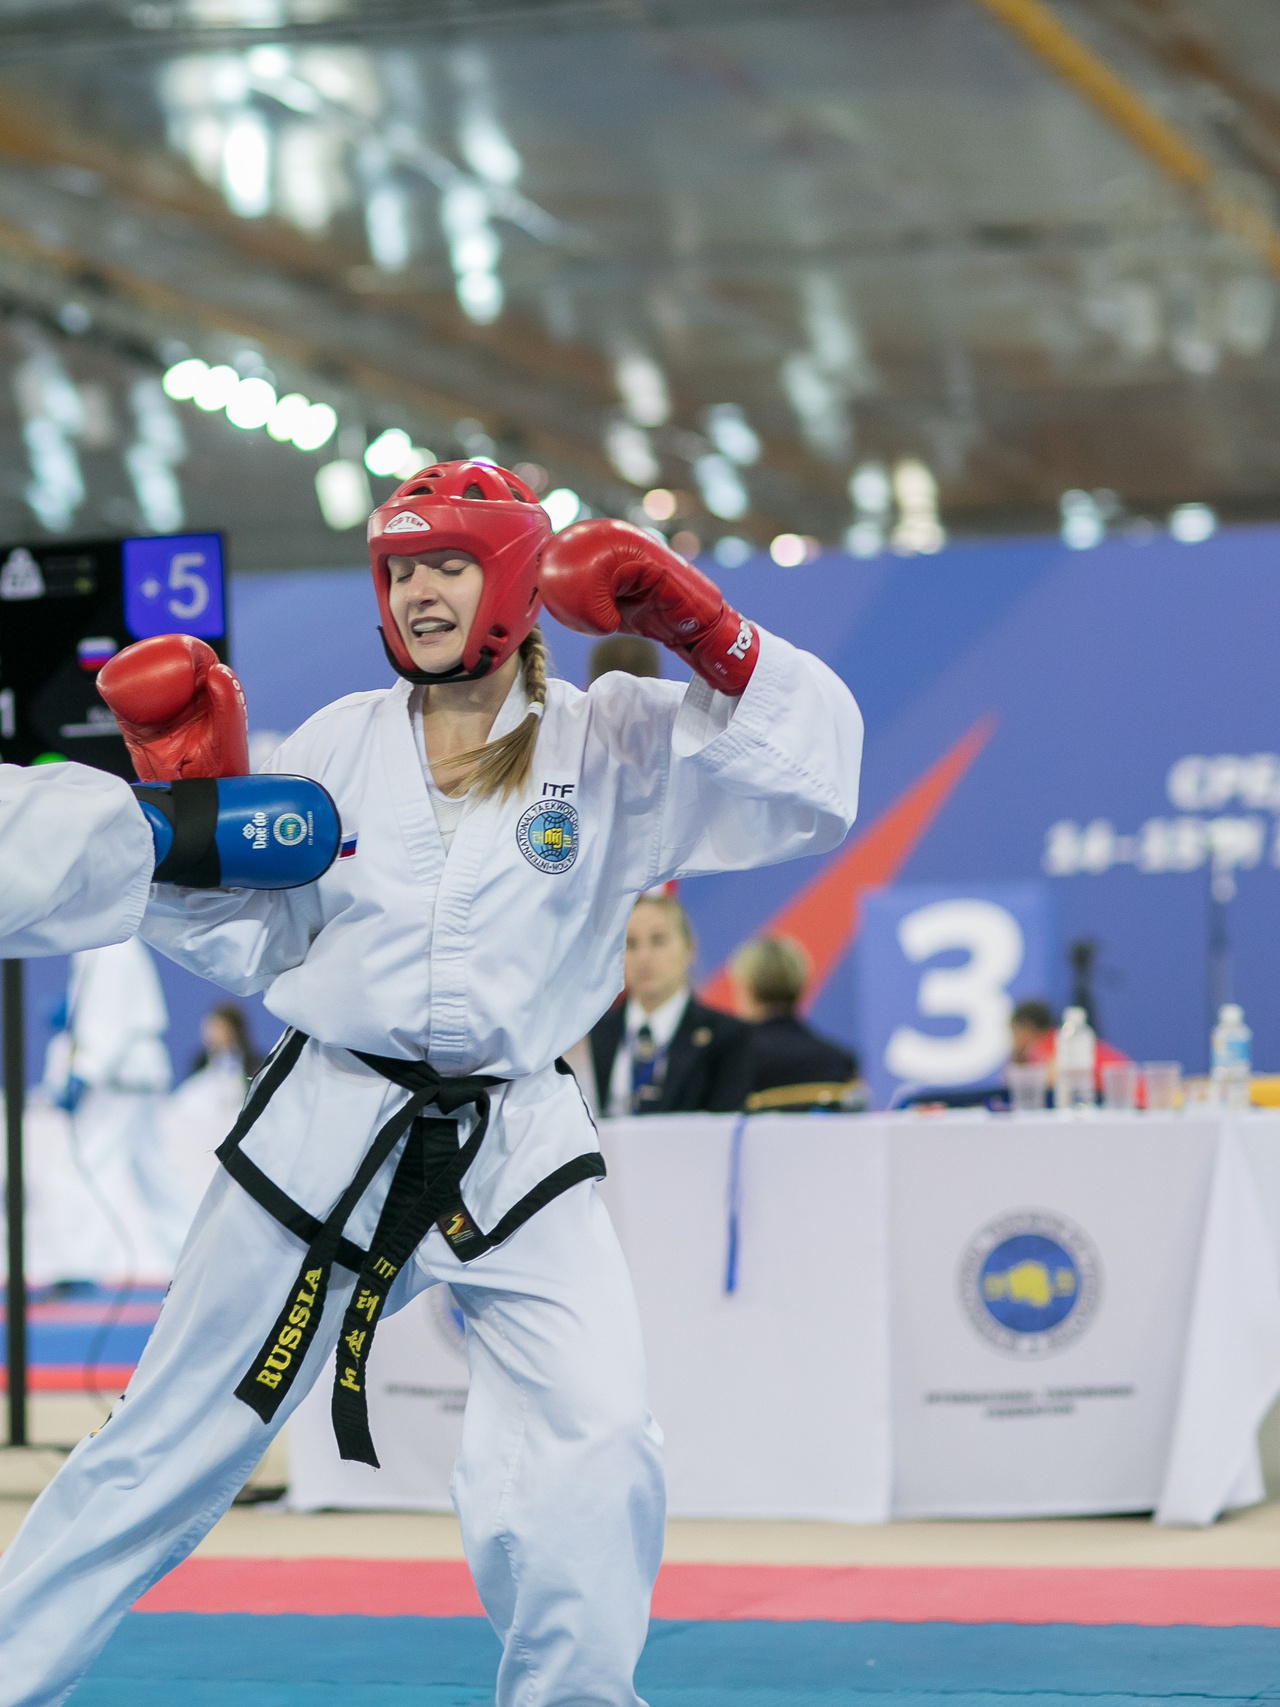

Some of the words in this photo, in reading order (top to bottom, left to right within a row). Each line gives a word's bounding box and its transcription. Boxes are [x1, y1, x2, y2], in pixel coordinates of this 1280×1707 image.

[541, 782, 575, 798] ITF
[885, 898, 1024, 1086] 3
[373, 1256, 397, 1280] ITF
[256, 1267, 323, 1390] RUSSIA
